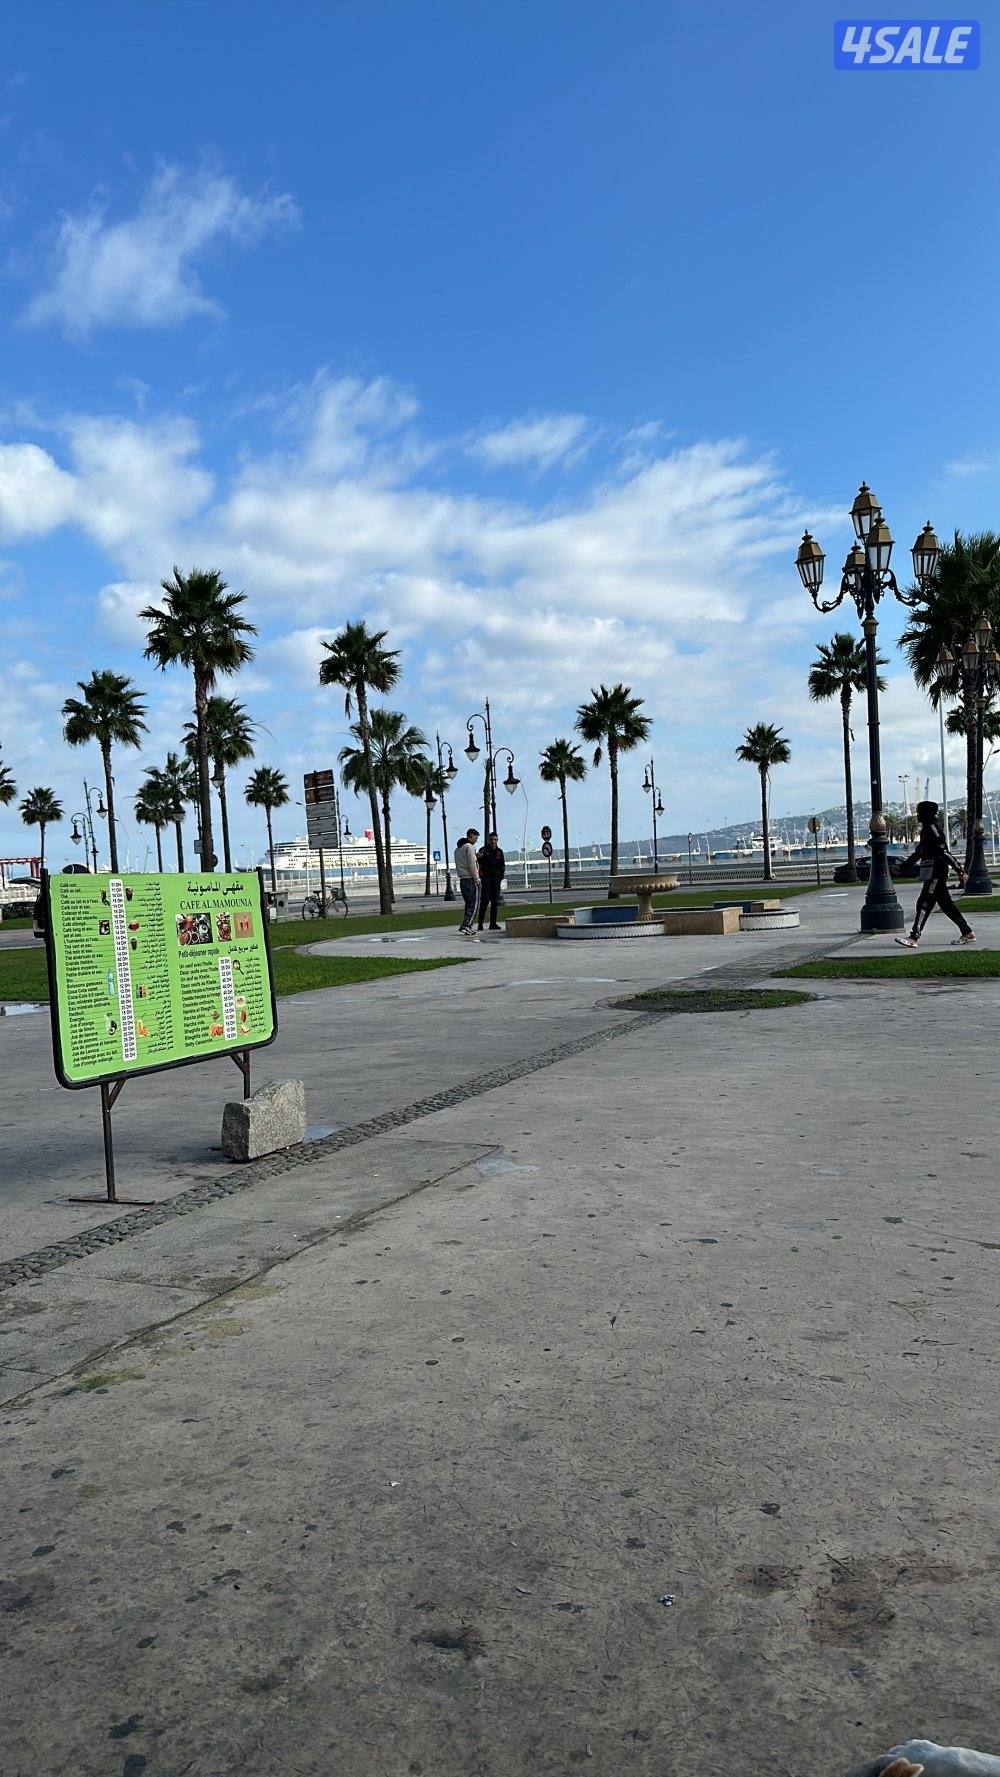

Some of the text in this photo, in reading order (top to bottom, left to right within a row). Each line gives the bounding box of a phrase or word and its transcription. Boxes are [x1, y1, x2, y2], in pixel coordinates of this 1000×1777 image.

[186, 880, 243, 896] مقهى المامونية
[179, 898, 252, 909] CAFE AL MAMOUNIA
